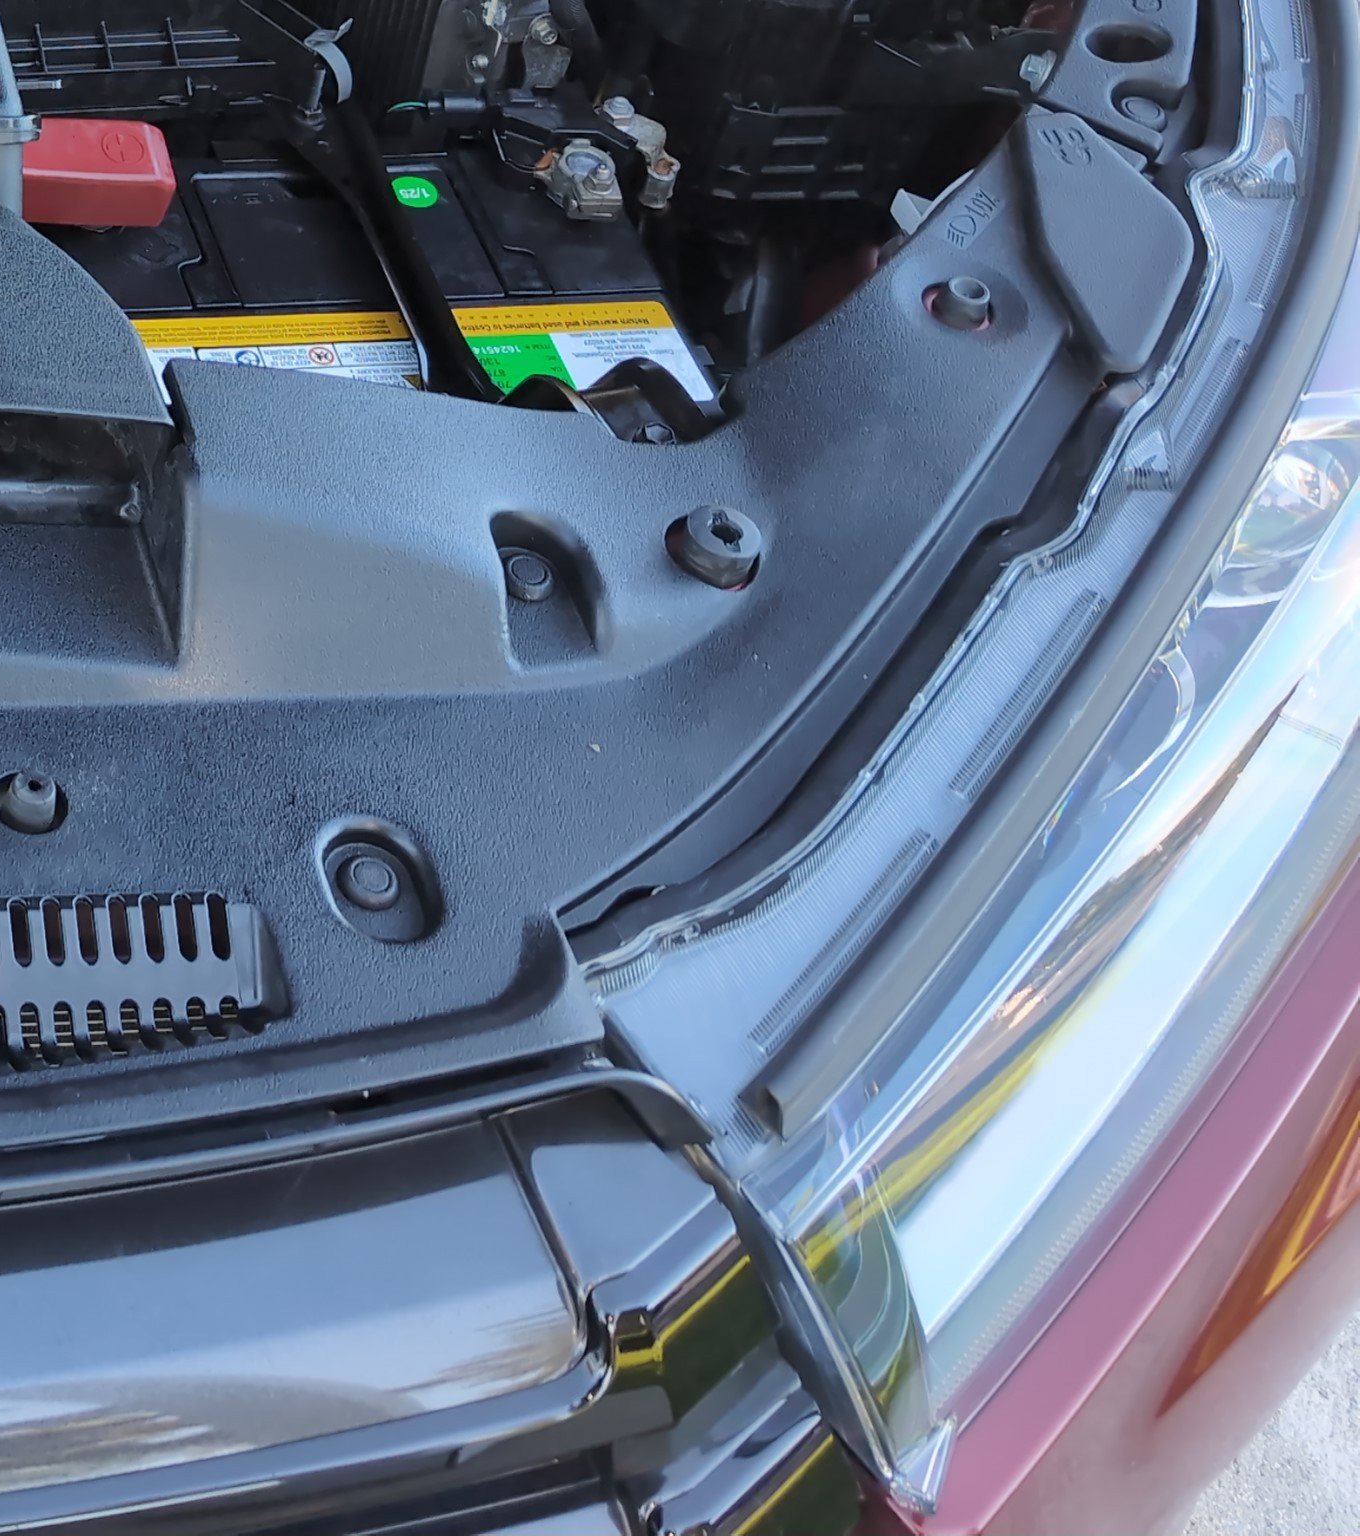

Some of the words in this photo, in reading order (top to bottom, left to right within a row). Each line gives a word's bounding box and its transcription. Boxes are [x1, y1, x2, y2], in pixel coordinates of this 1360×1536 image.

[399, 188, 430, 199] 1/25
[461, 324, 491, 332] Costco
[505, 323, 541, 331] batteries
[472, 345, 521, 354] 1624514
